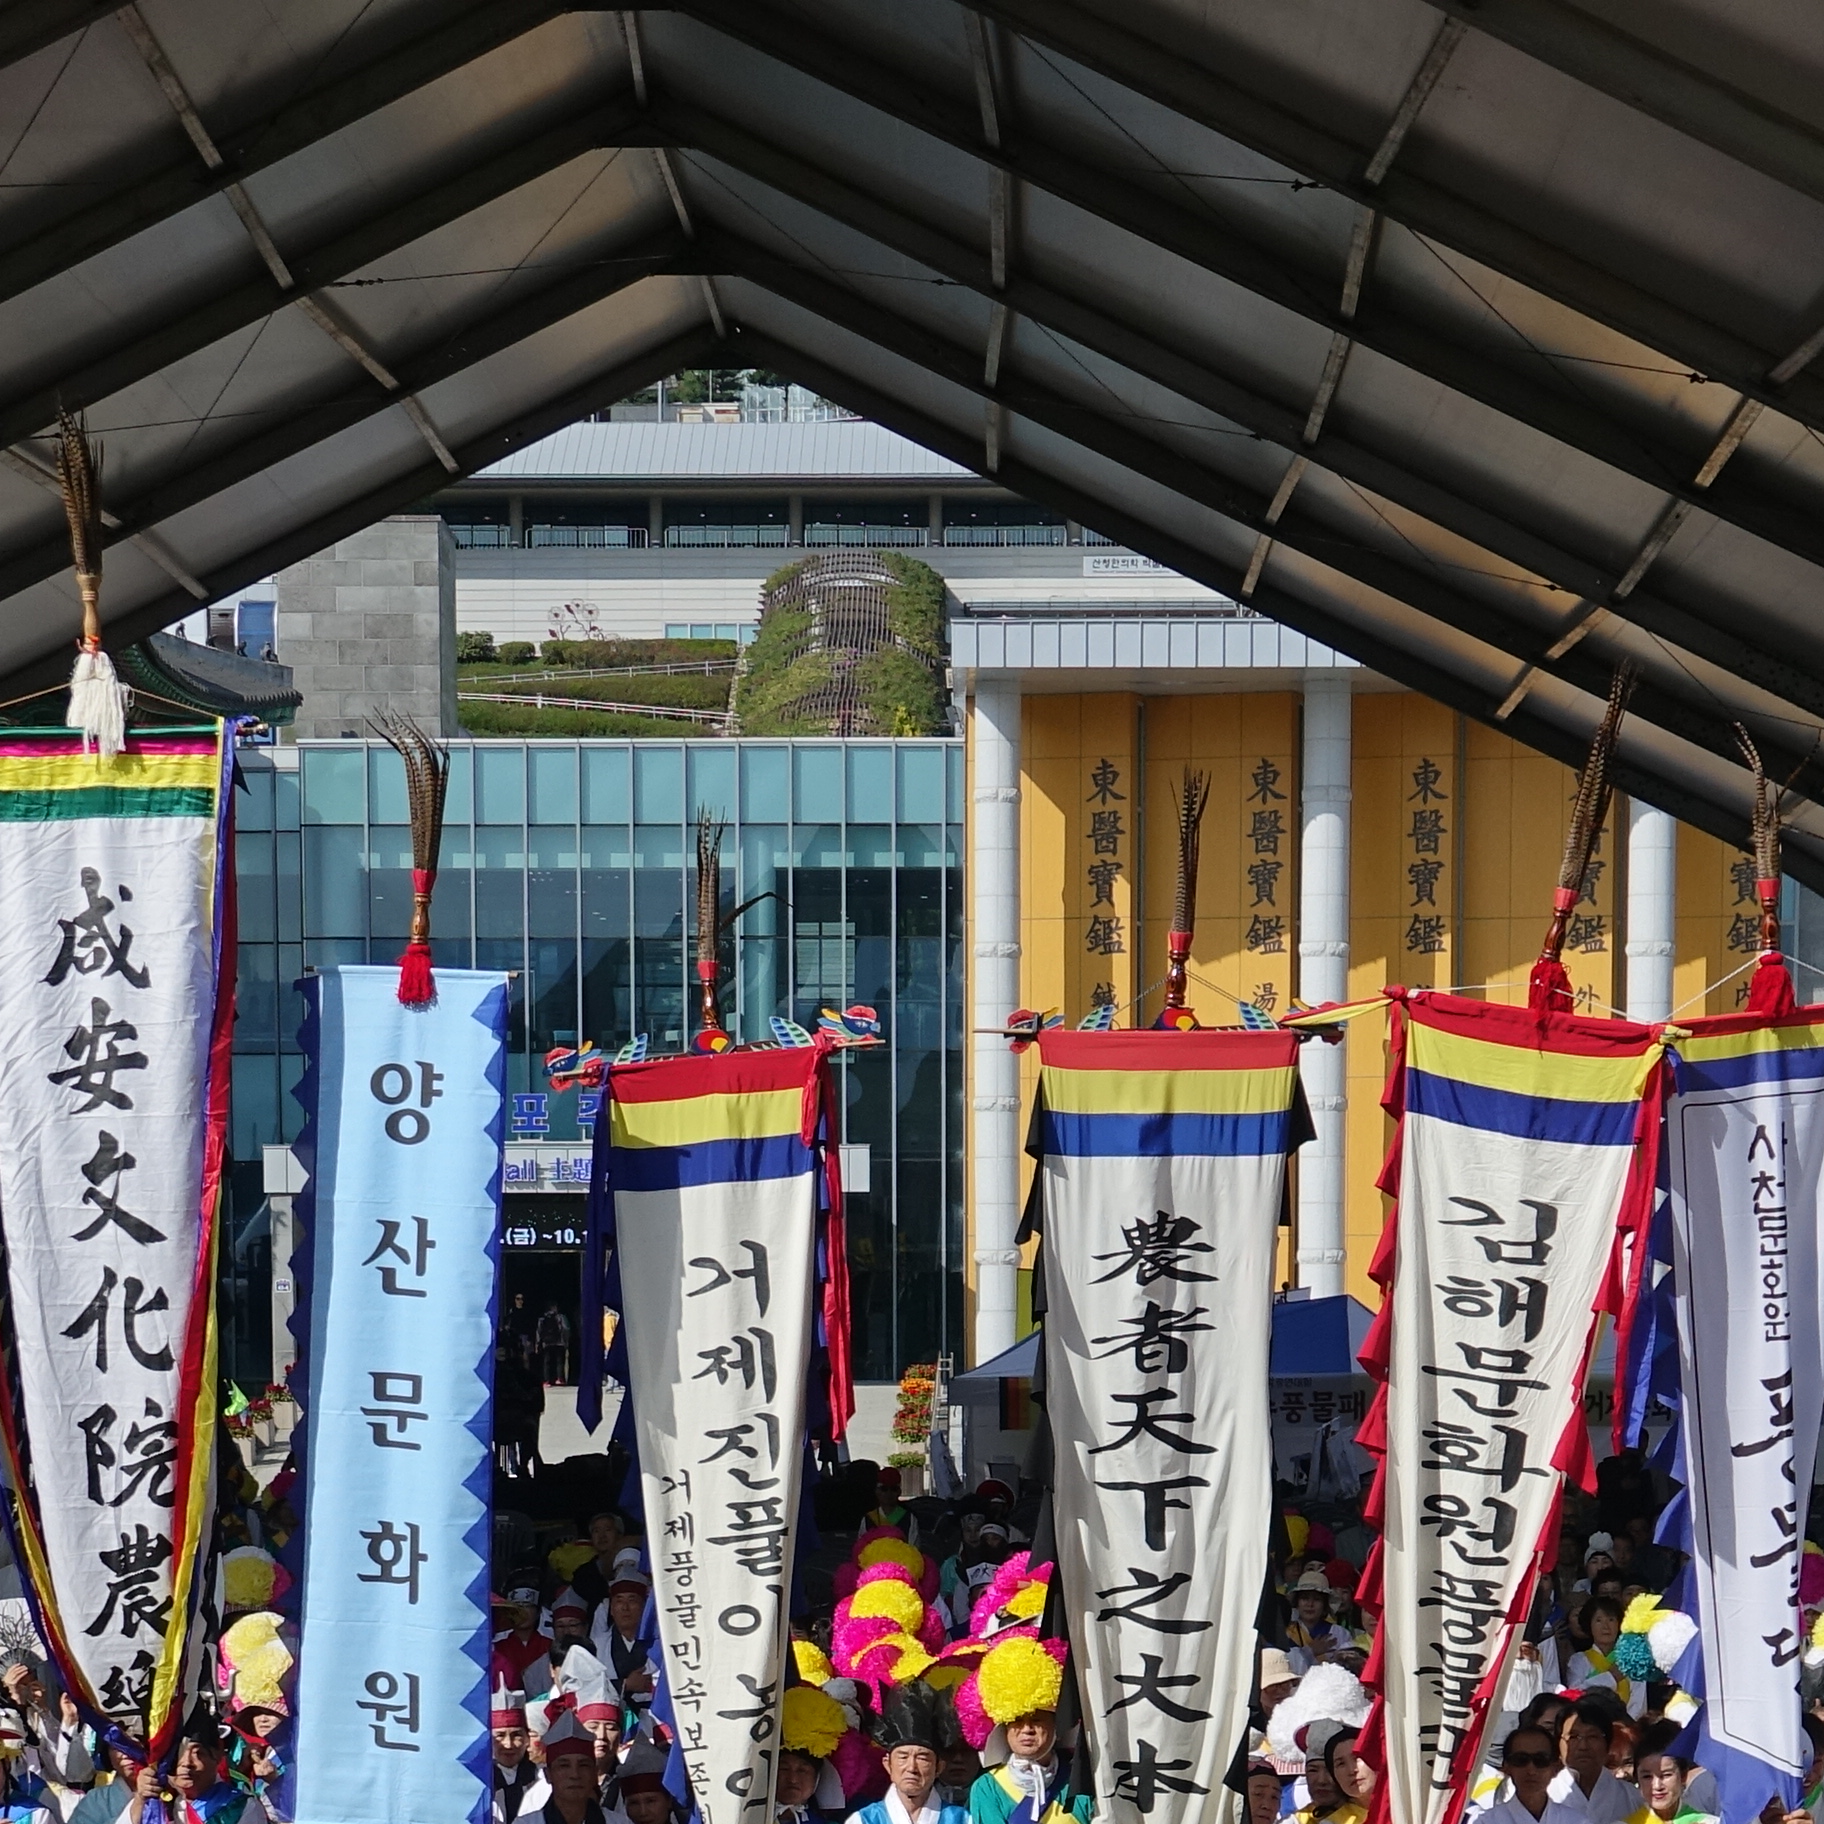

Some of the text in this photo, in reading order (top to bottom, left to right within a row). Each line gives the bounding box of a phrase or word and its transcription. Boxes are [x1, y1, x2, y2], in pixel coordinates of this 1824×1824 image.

[1086, 758, 1127, 955] 東醫寶鑑
[1246, 758, 1288, 955] 東醫寶鑑
[1405, 758, 1449, 954] 東醫寶鑑
[356, 1059, 446, 1752] 양산문화원
[1087, 1211, 1219, 1814] 農者天下之大本
